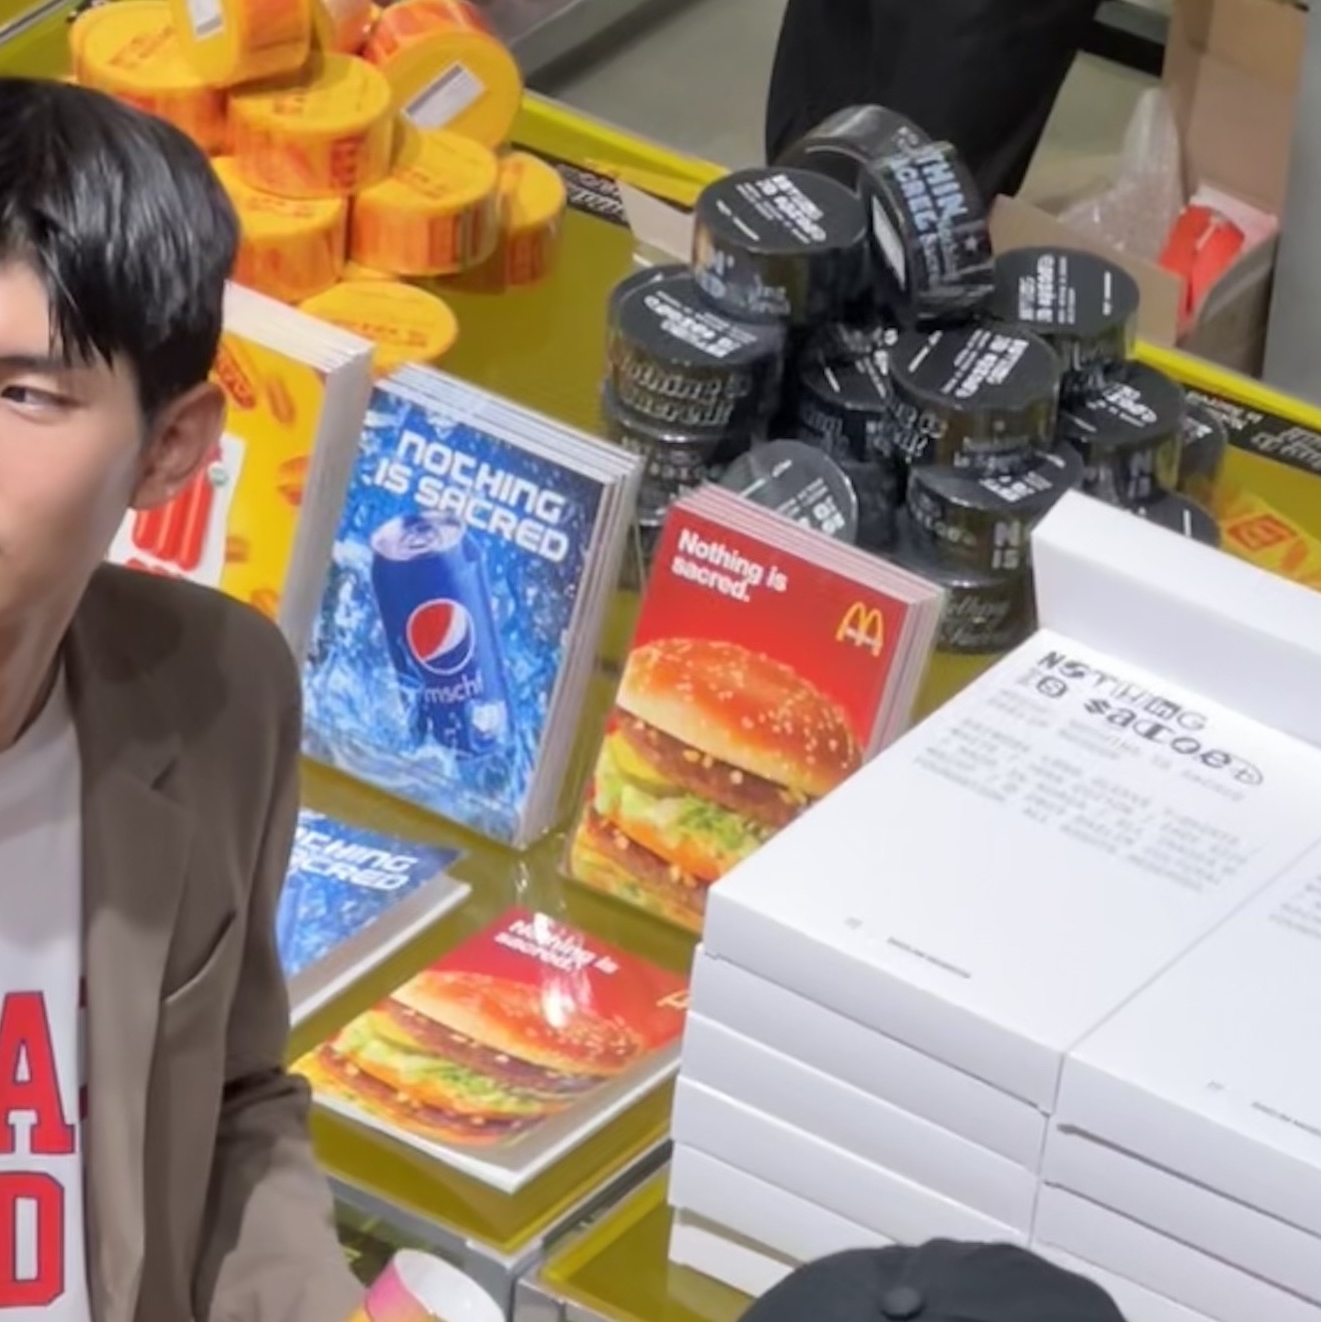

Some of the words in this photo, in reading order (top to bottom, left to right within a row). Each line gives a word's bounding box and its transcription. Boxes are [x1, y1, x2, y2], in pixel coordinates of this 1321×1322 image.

[375, 457, 412, 495] IS
[414, 475, 569, 563] SACRED
[397, 429, 566, 525] NOTHING
[672, 556, 750, 603] sacred.
[678, 529, 763, 587] Nothing
[766, 566, 787, 592] is
